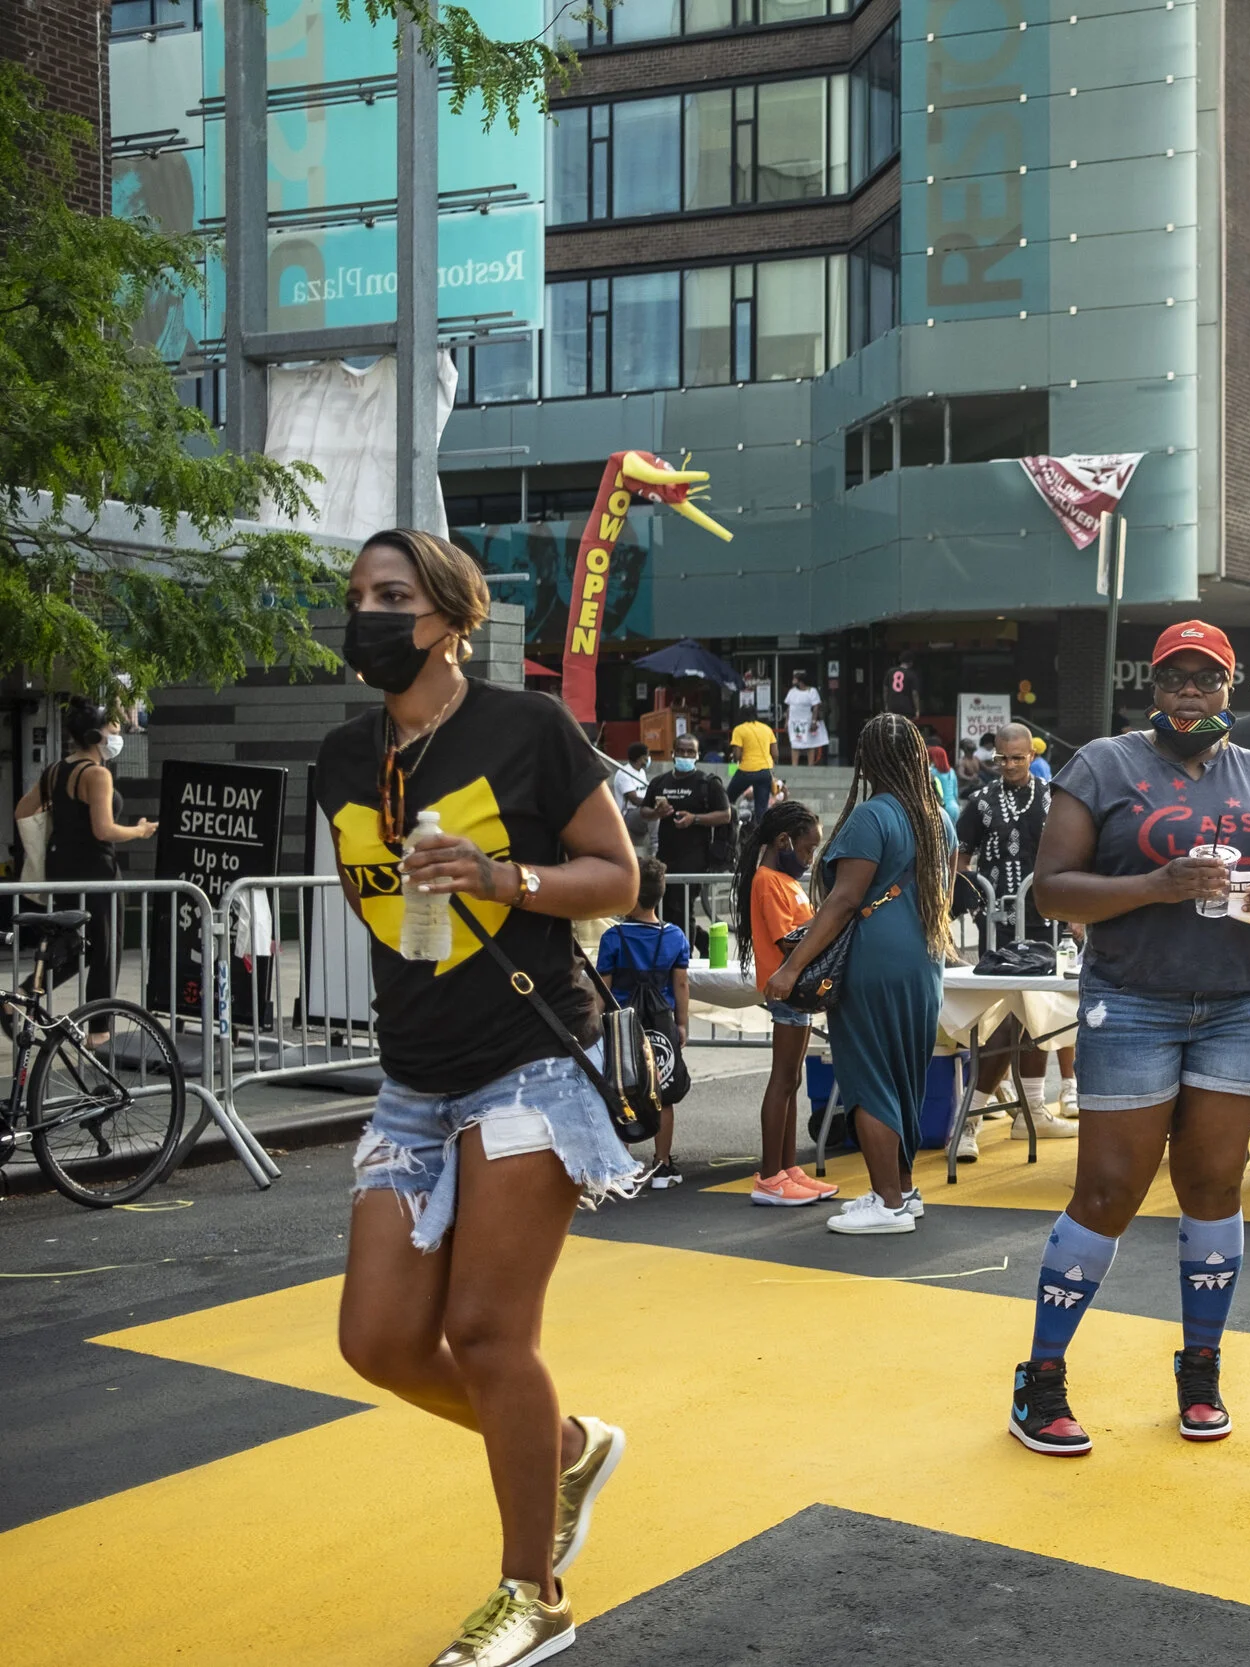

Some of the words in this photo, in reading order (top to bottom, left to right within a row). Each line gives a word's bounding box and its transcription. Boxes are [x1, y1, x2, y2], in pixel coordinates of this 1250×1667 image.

[571, 548, 610, 656] OPEN
[892, 670, 905, 692] 8
[180, 783, 217, 807] ALL
[223, 786, 263, 811] DAY
[180, 810, 258, 839] SPECIAL
[194, 848, 217, 873] Up
[222, 852, 240, 870] to
[219, 966, 228, 1034] NYPD
